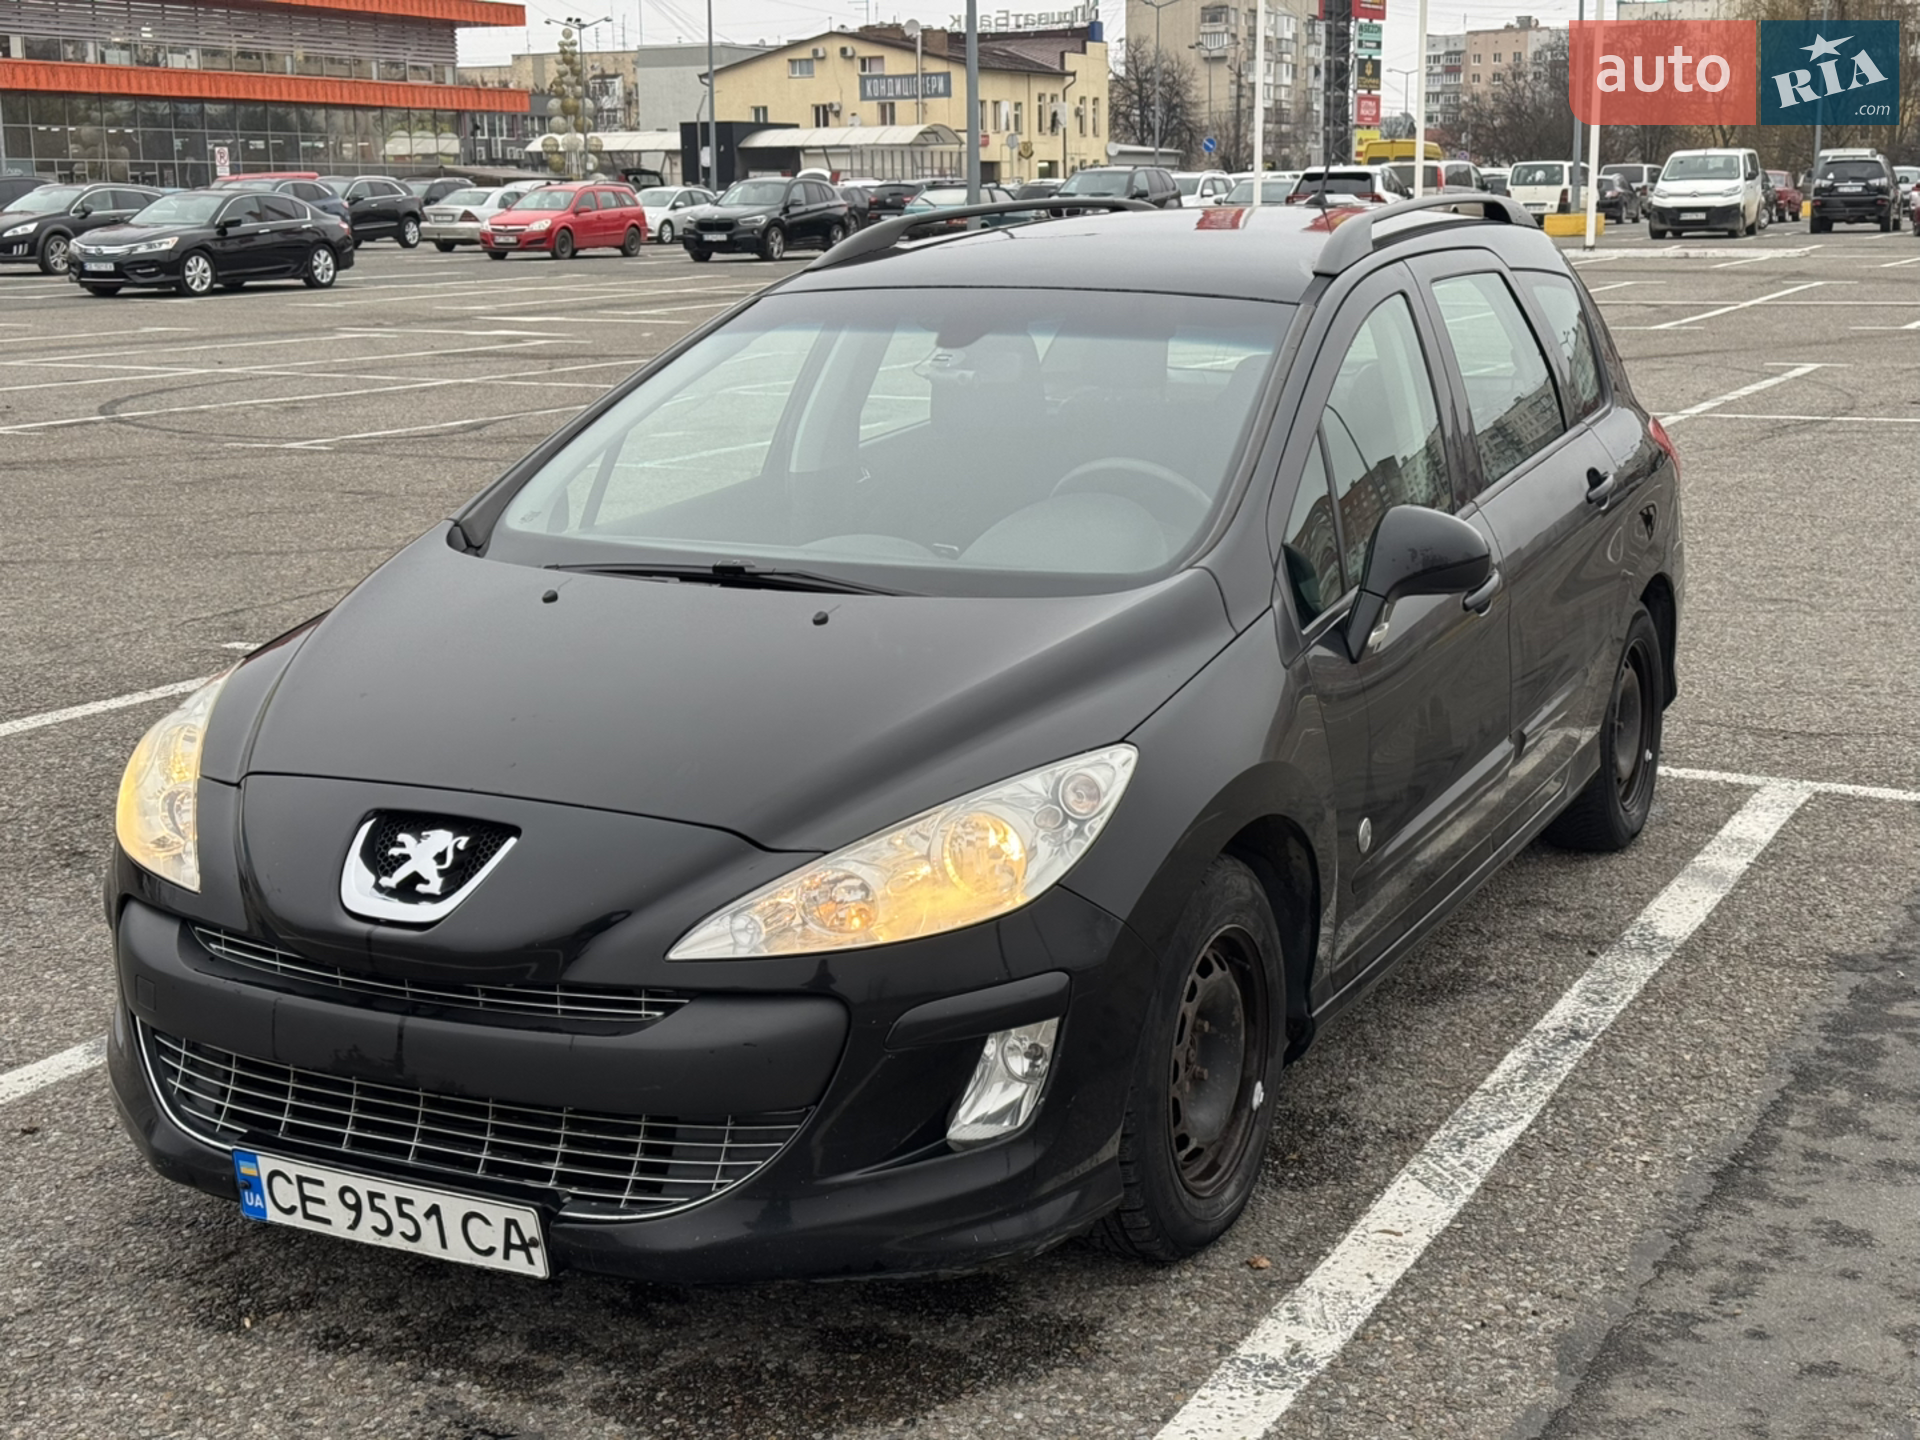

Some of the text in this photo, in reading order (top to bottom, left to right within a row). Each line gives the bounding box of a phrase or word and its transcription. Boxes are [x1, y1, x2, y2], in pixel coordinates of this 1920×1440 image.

[245, 1190, 264, 1209] UA
[266, 1169, 536, 1266] CE 9551 CA
